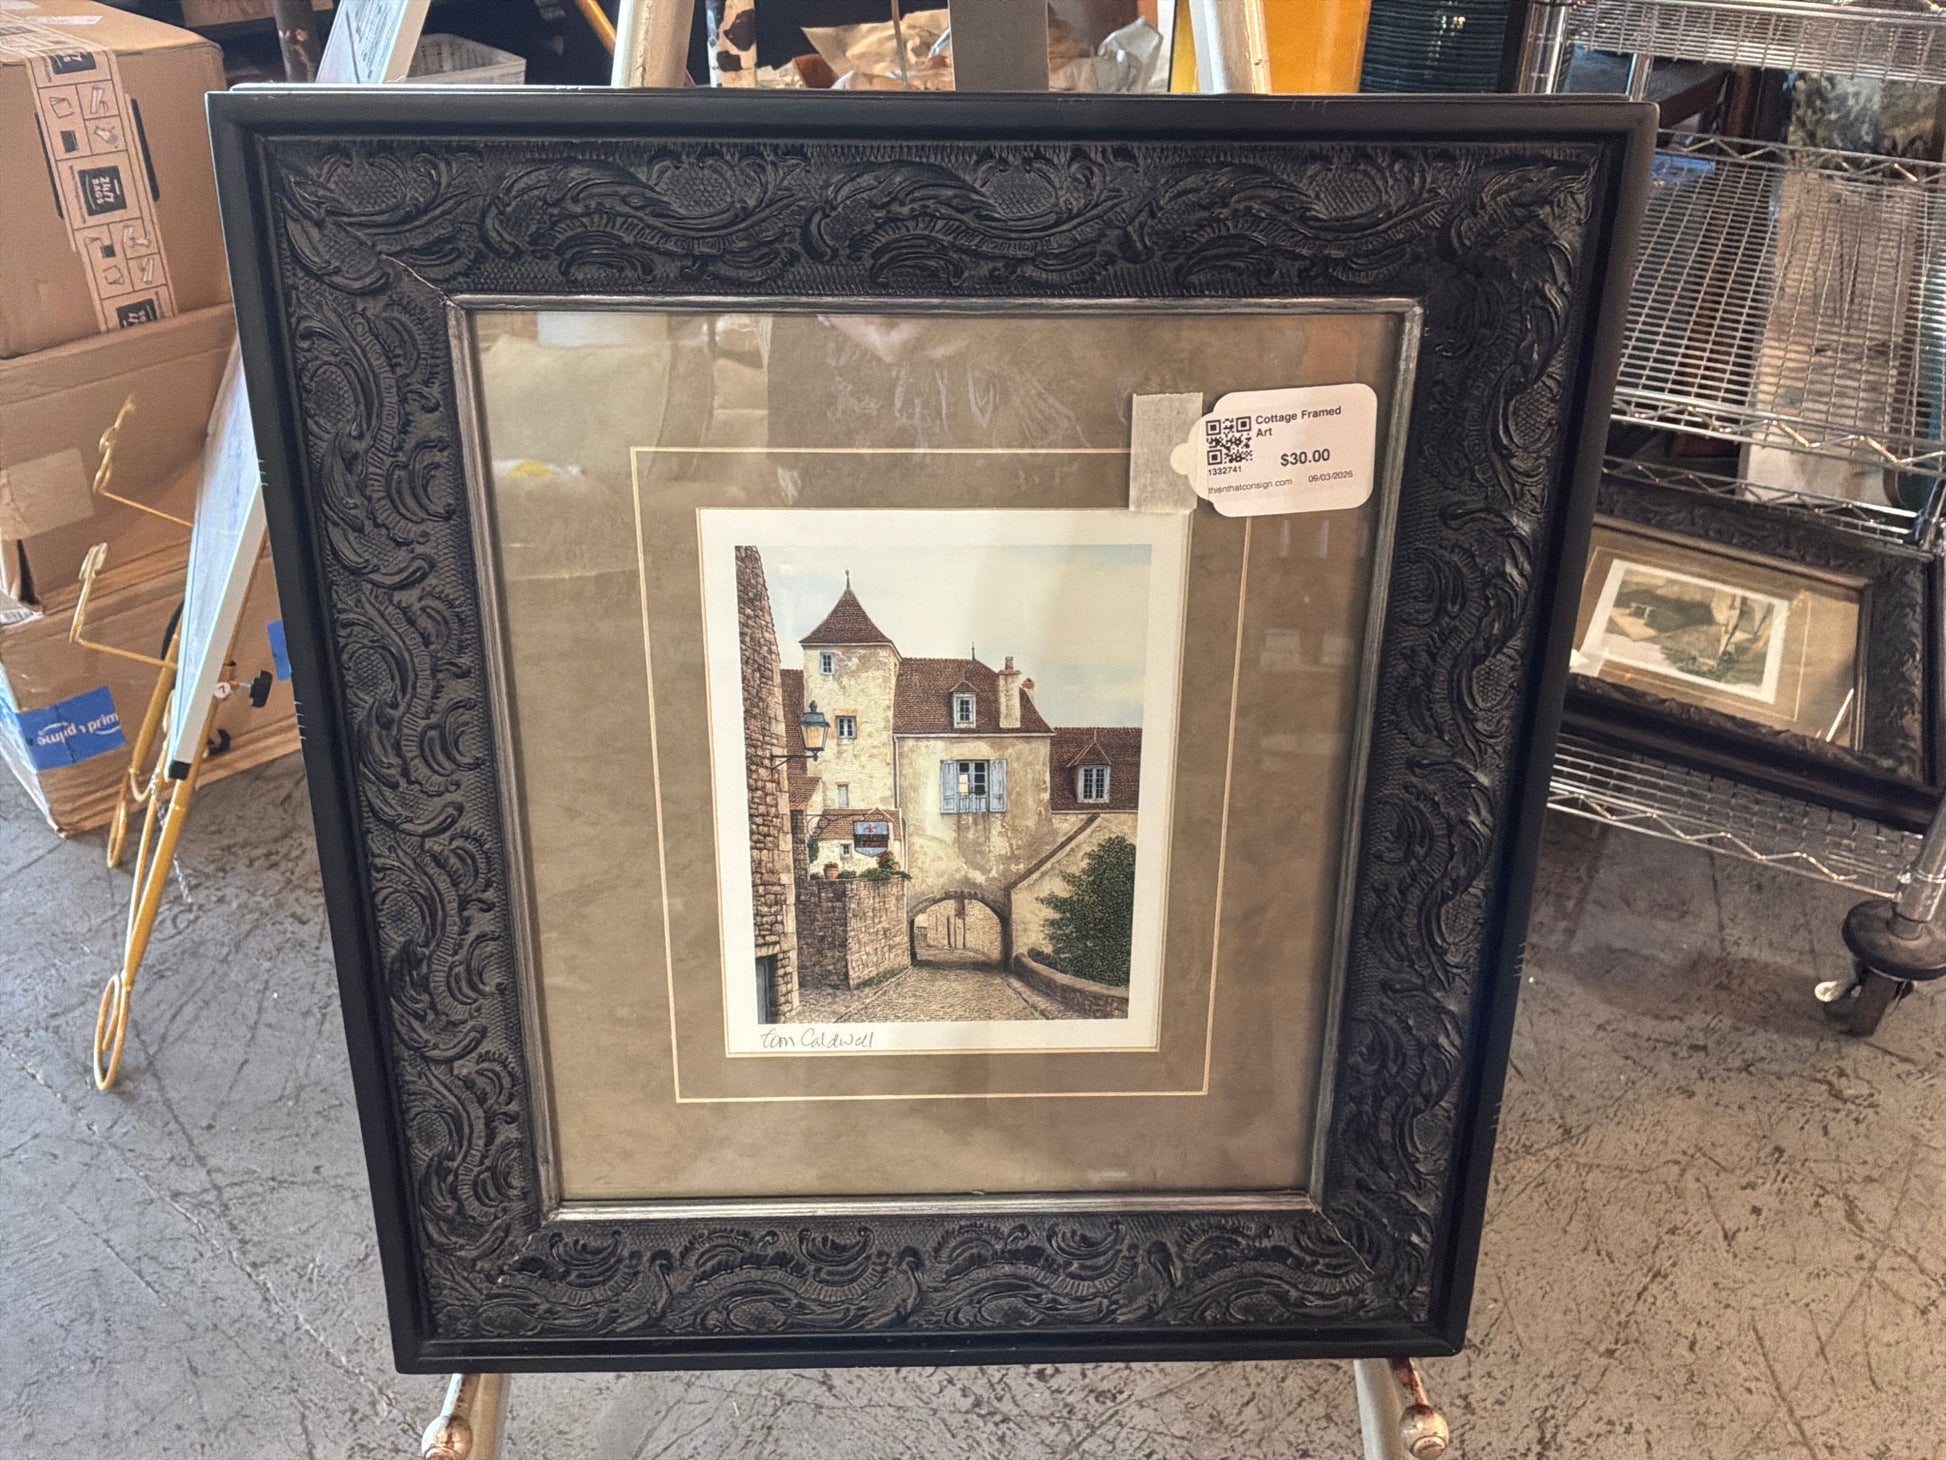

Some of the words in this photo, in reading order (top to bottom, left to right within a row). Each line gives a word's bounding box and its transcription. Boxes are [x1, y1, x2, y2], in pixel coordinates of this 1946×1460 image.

[1255, 413, 1298, 425] Cottage
[1301, 405, 1342, 419] Framed
[1256, 427, 1273, 437] Art
[1280, 448, 1331, 467] $30.00
[1208, 465, 1242, 476] 1332741
[87, 713, 119, 734] prim
